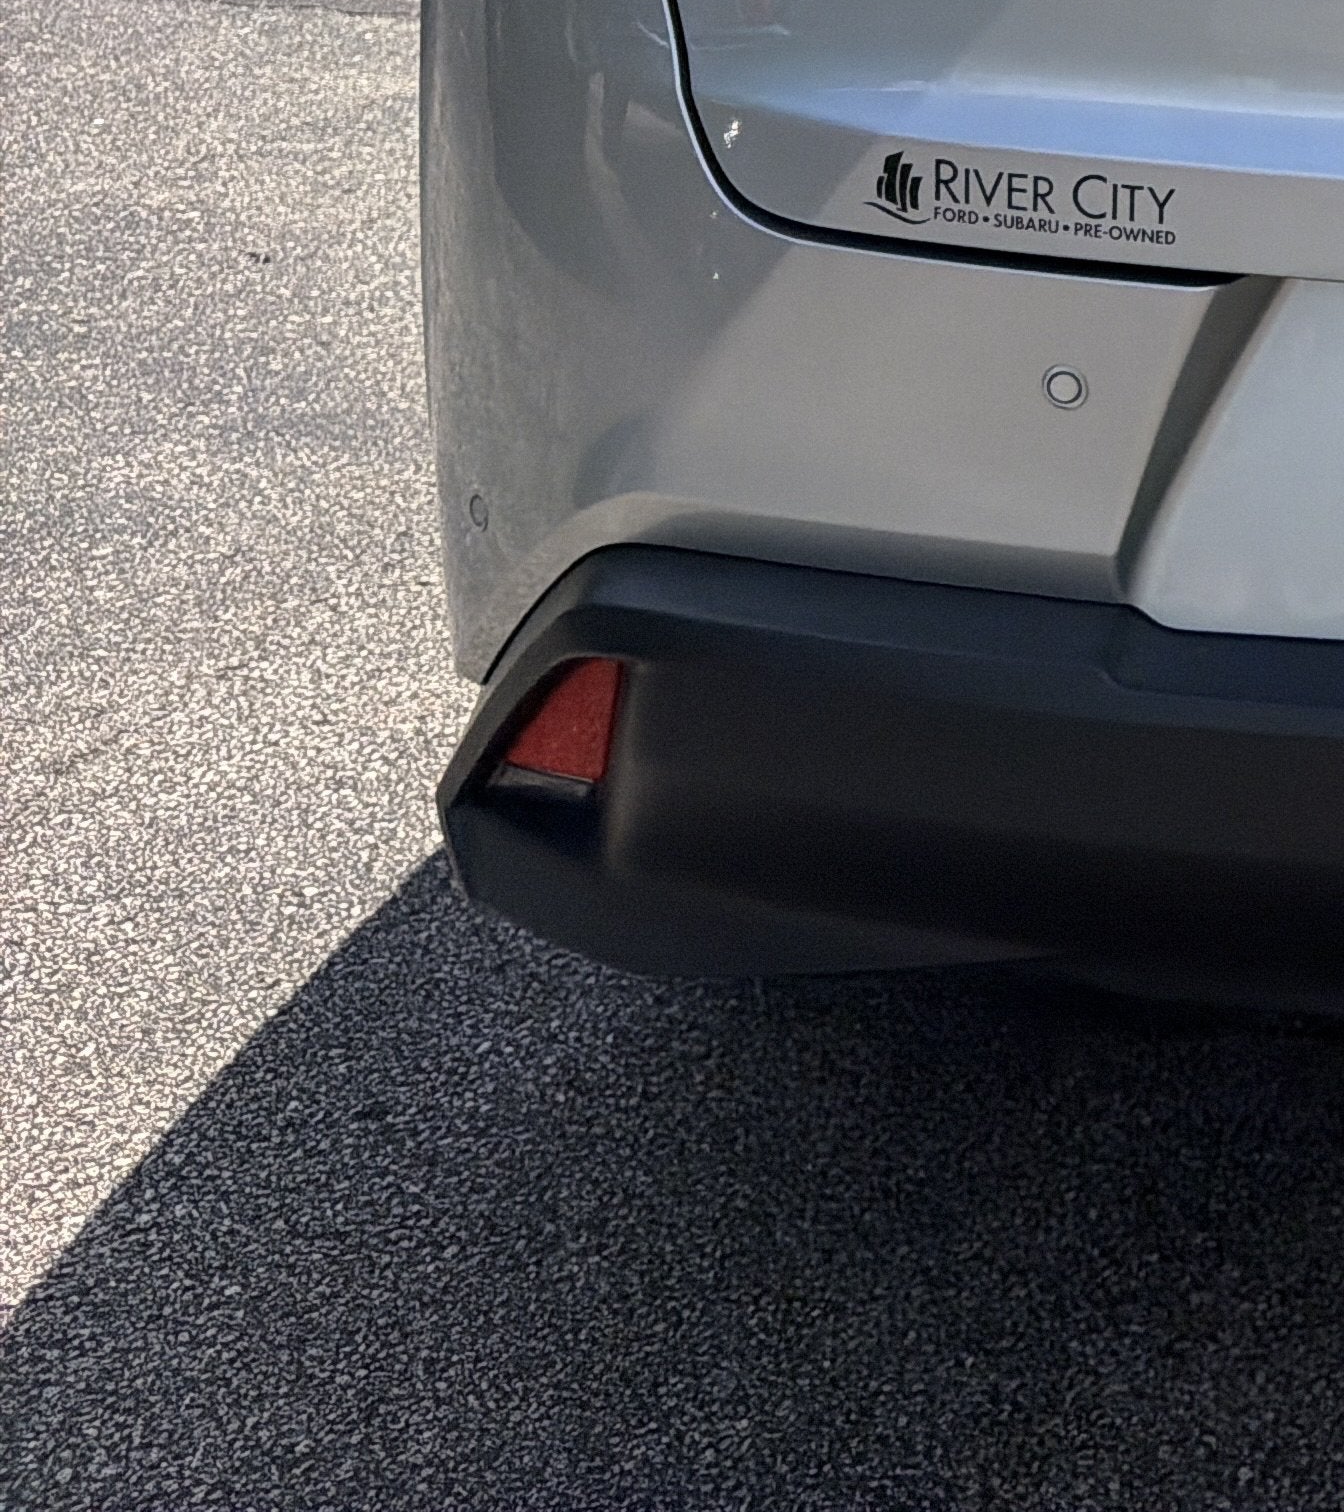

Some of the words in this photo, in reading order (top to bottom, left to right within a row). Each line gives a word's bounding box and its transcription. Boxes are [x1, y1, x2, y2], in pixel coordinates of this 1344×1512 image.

[934, 158, 1055, 215] RIVER
[1072, 174, 1177, 225] CITY
[933, 206, 980, 225] FORD
[993, 213, 1060, 235] SUBARU
[1073, 224, 1177, 246] PRE-OWNED
